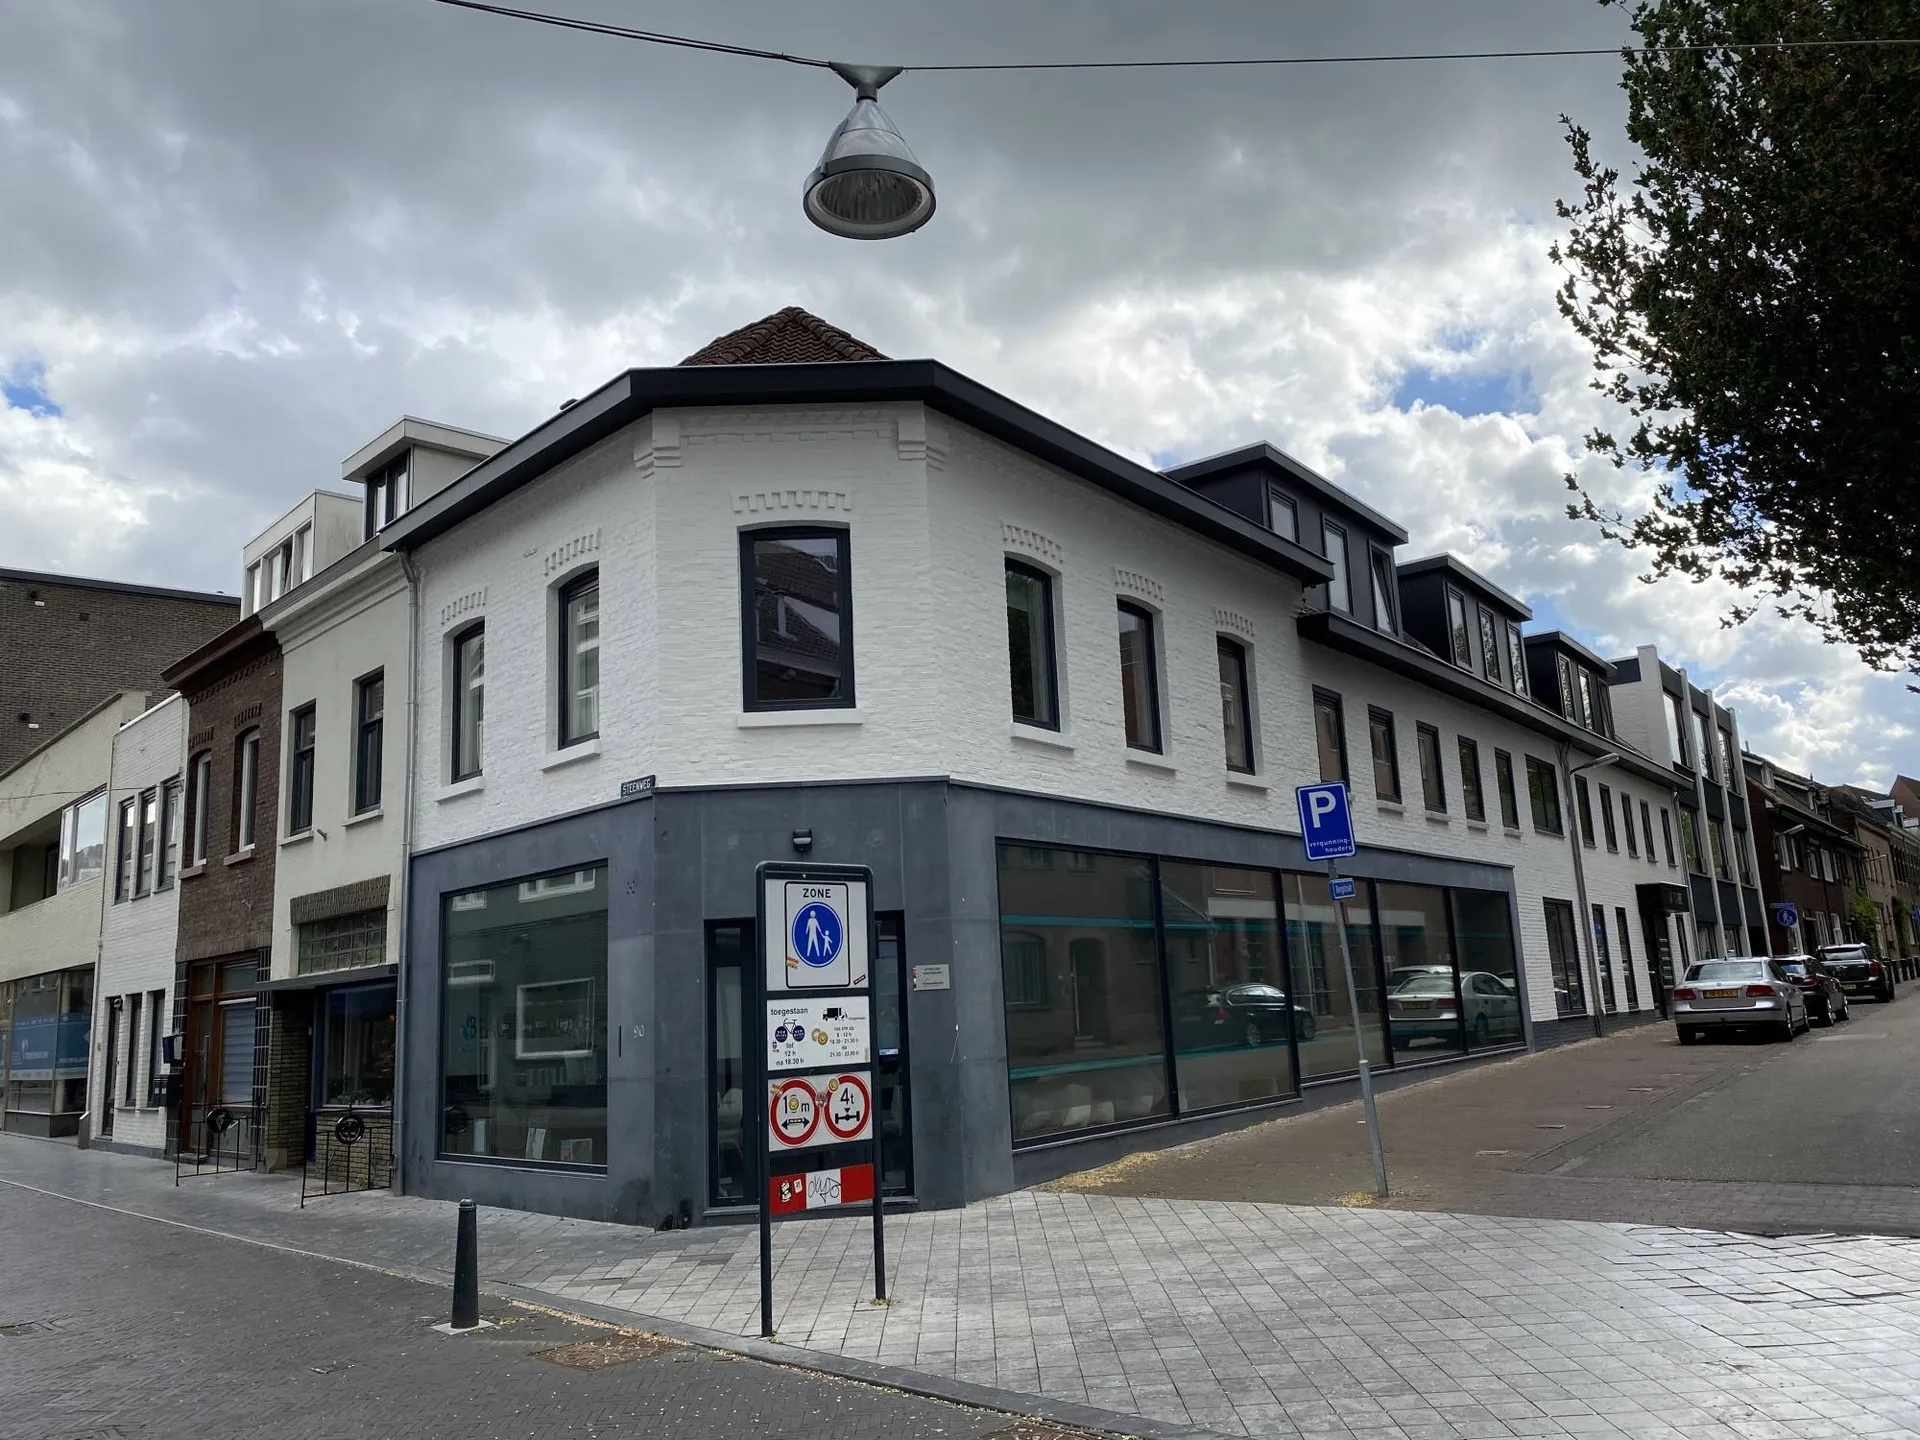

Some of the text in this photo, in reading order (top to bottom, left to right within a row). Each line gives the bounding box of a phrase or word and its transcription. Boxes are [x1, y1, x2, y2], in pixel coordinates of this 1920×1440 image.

[622, 778, 651, 795] STEENWEG
[1308, 790, 1337, 829] P
[1308, 838, 1351, 848] vergunning-
[1325, 845, 1352, 853] houders
[802, 888, 832, 899] ZONE
[770, 1007, 809, 1017] toegestaan
